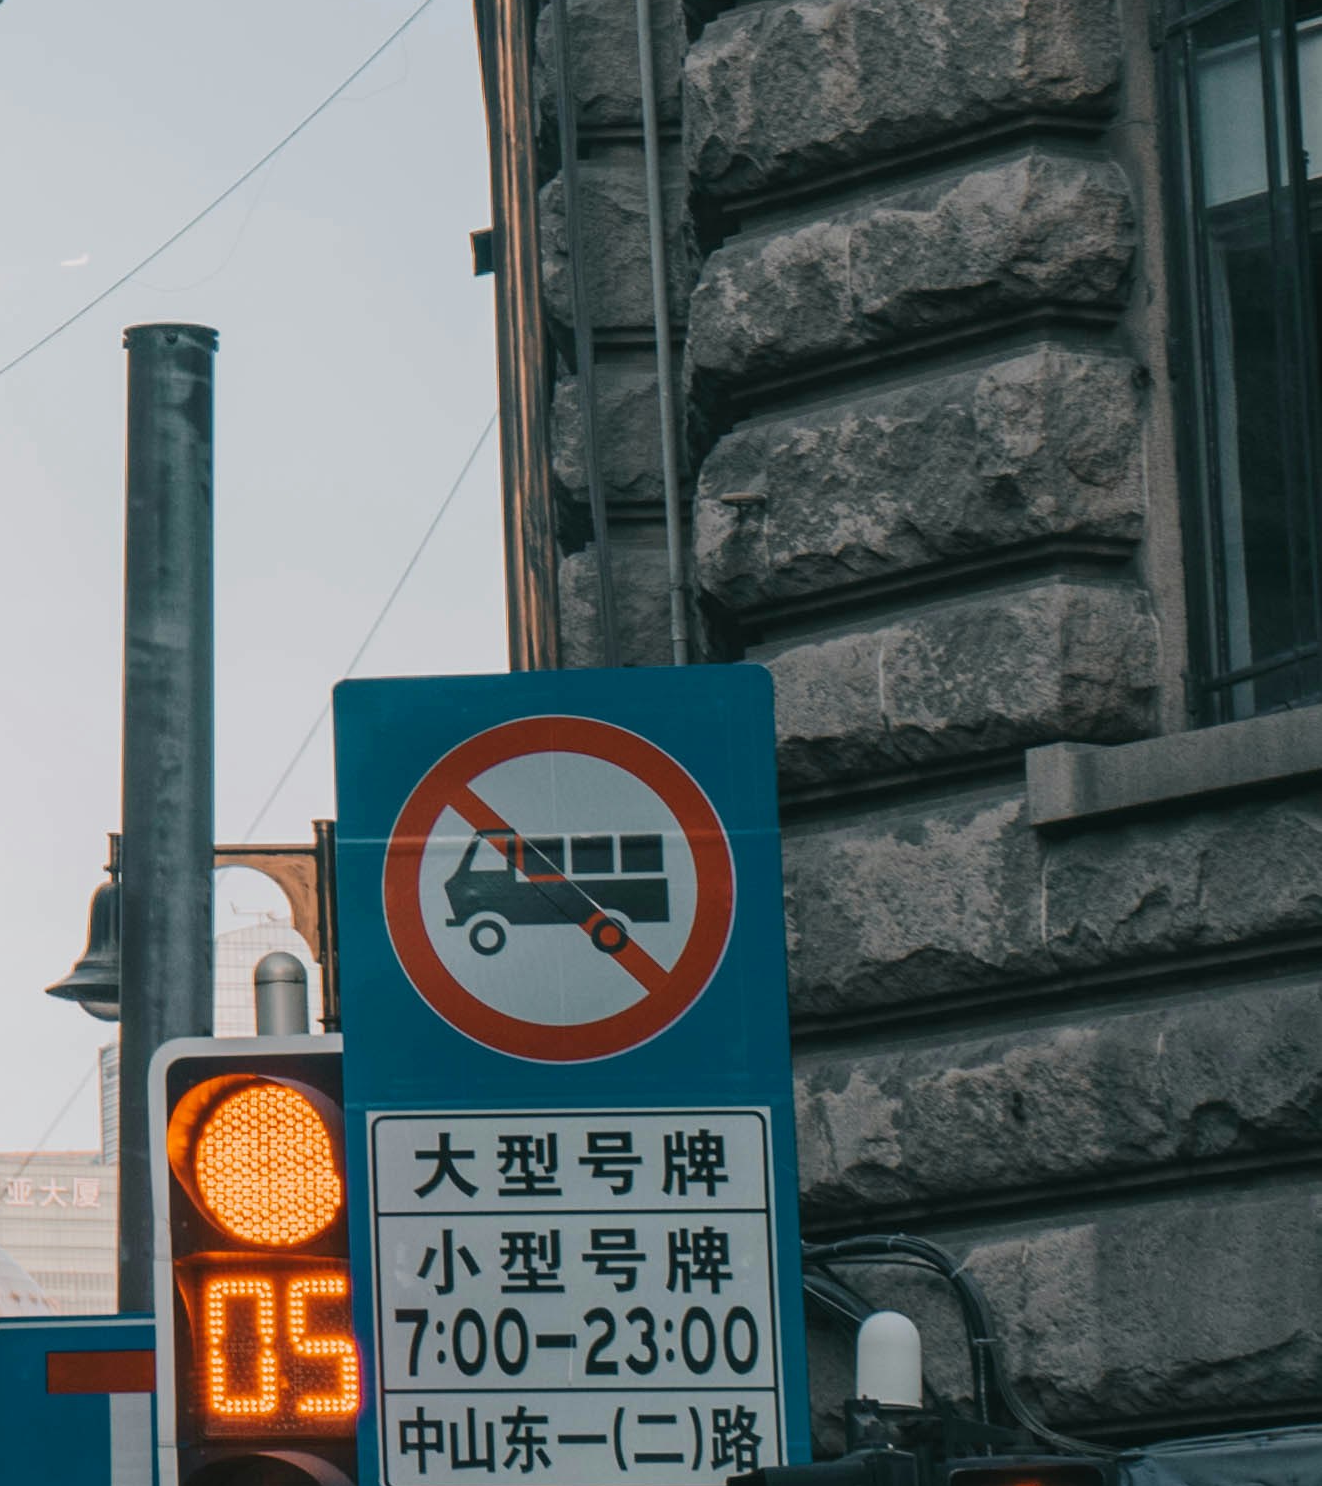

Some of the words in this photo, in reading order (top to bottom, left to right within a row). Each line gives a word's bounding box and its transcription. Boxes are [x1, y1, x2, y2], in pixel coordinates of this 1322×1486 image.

[414, 1129, 729, 1198] 大型号牌
[417, 1226, 734, 1295] 小型号牌
[208, 1278, 358, 1414] 05
[399, 1404, 763, 1475] 中山东一(二)路
